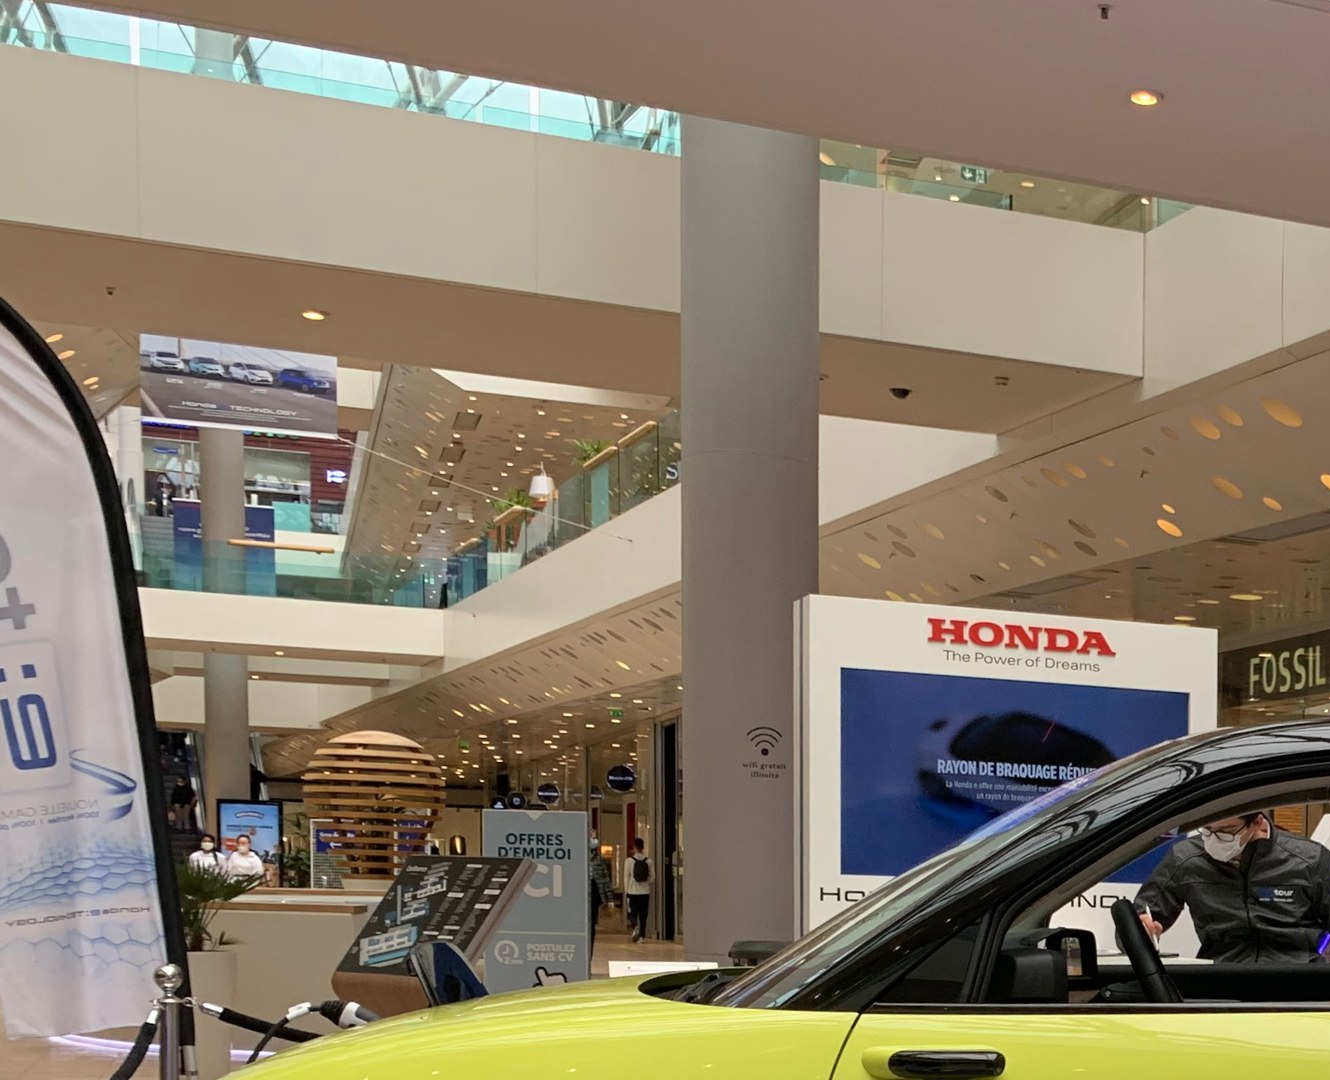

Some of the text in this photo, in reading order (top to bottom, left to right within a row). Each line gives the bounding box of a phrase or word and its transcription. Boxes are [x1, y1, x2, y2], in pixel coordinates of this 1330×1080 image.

[927, 618, 1116, 657] HONDA
[943, 650, 1101, 672] The Power of Dreams
[1249, 645, 1326, 696] FOSSIL
[750, 770, 779, 778] illimité
[937, 759, 977, 775] RAYON
[979, 761, 994, 776] DE
[996, 762, 1057, 780] BRAQUAGE
[505, 833, 563, 846] OFFRES
[498, 847, 571, 860] D'EMPLOI
[526, 943, 576, 953] POSTULEZ
[526, 952, 574, 962] SANS CV
